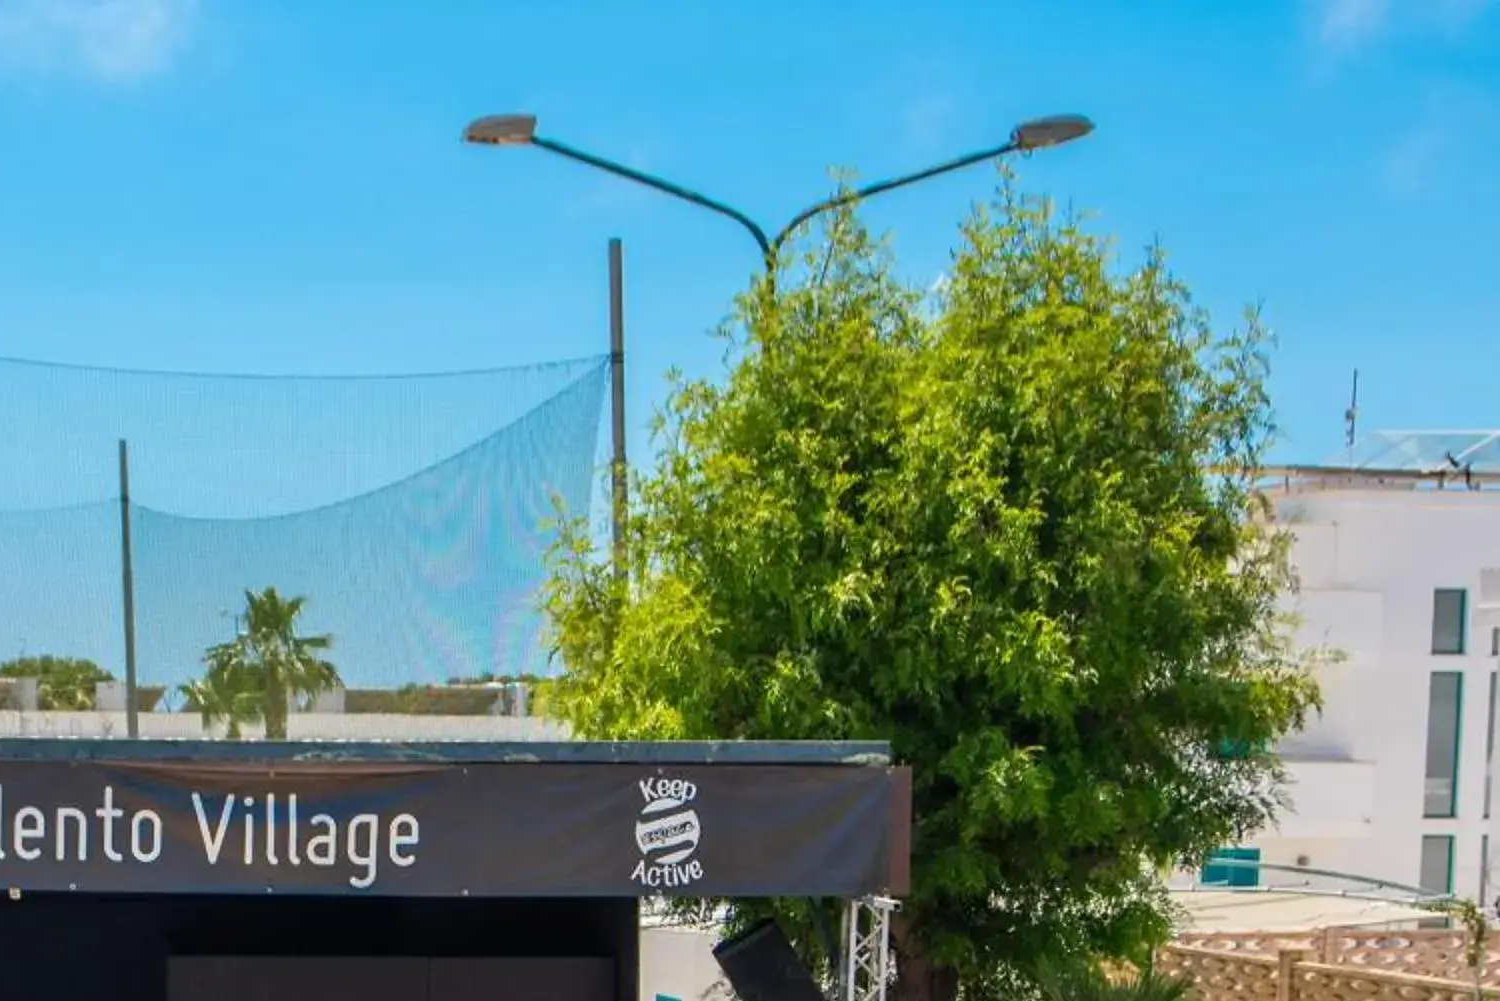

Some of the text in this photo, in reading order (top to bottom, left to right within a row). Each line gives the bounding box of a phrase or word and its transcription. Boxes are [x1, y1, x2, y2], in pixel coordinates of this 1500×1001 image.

[639, 777, 697, 802] Keep
[192, 793, 420, 888] Village
[630, 858, 704, 887] Active
